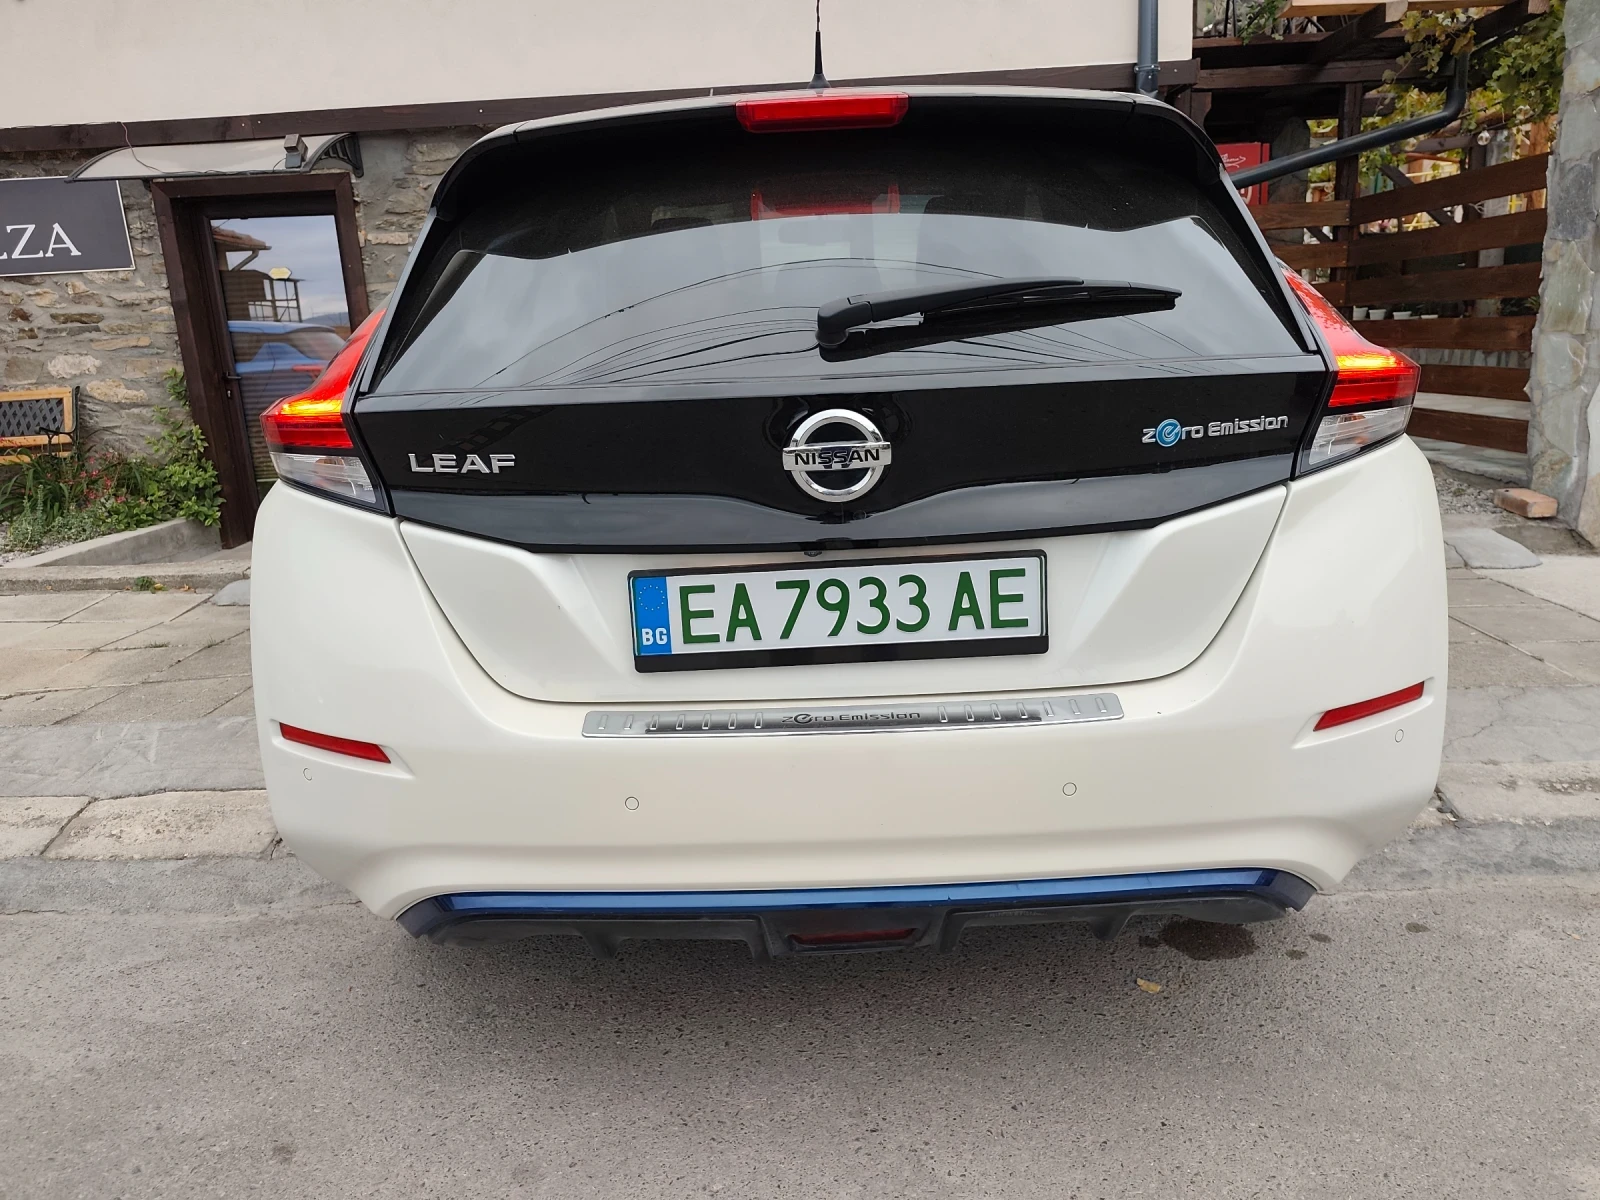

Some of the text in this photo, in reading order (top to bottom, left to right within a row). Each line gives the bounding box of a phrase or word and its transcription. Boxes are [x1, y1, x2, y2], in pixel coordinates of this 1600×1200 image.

[0, 222, 82, 259] ZA
[1207, 415, 1288, 437] Emission
[408, 453, 516, 473] LEAF
[794, 448, 880, 466] NISSAN
[679, 568, 1029, 645] EA 7933 AE
[641, 627, 668, 646] BG
[839, 711, 920, 722] Emission
